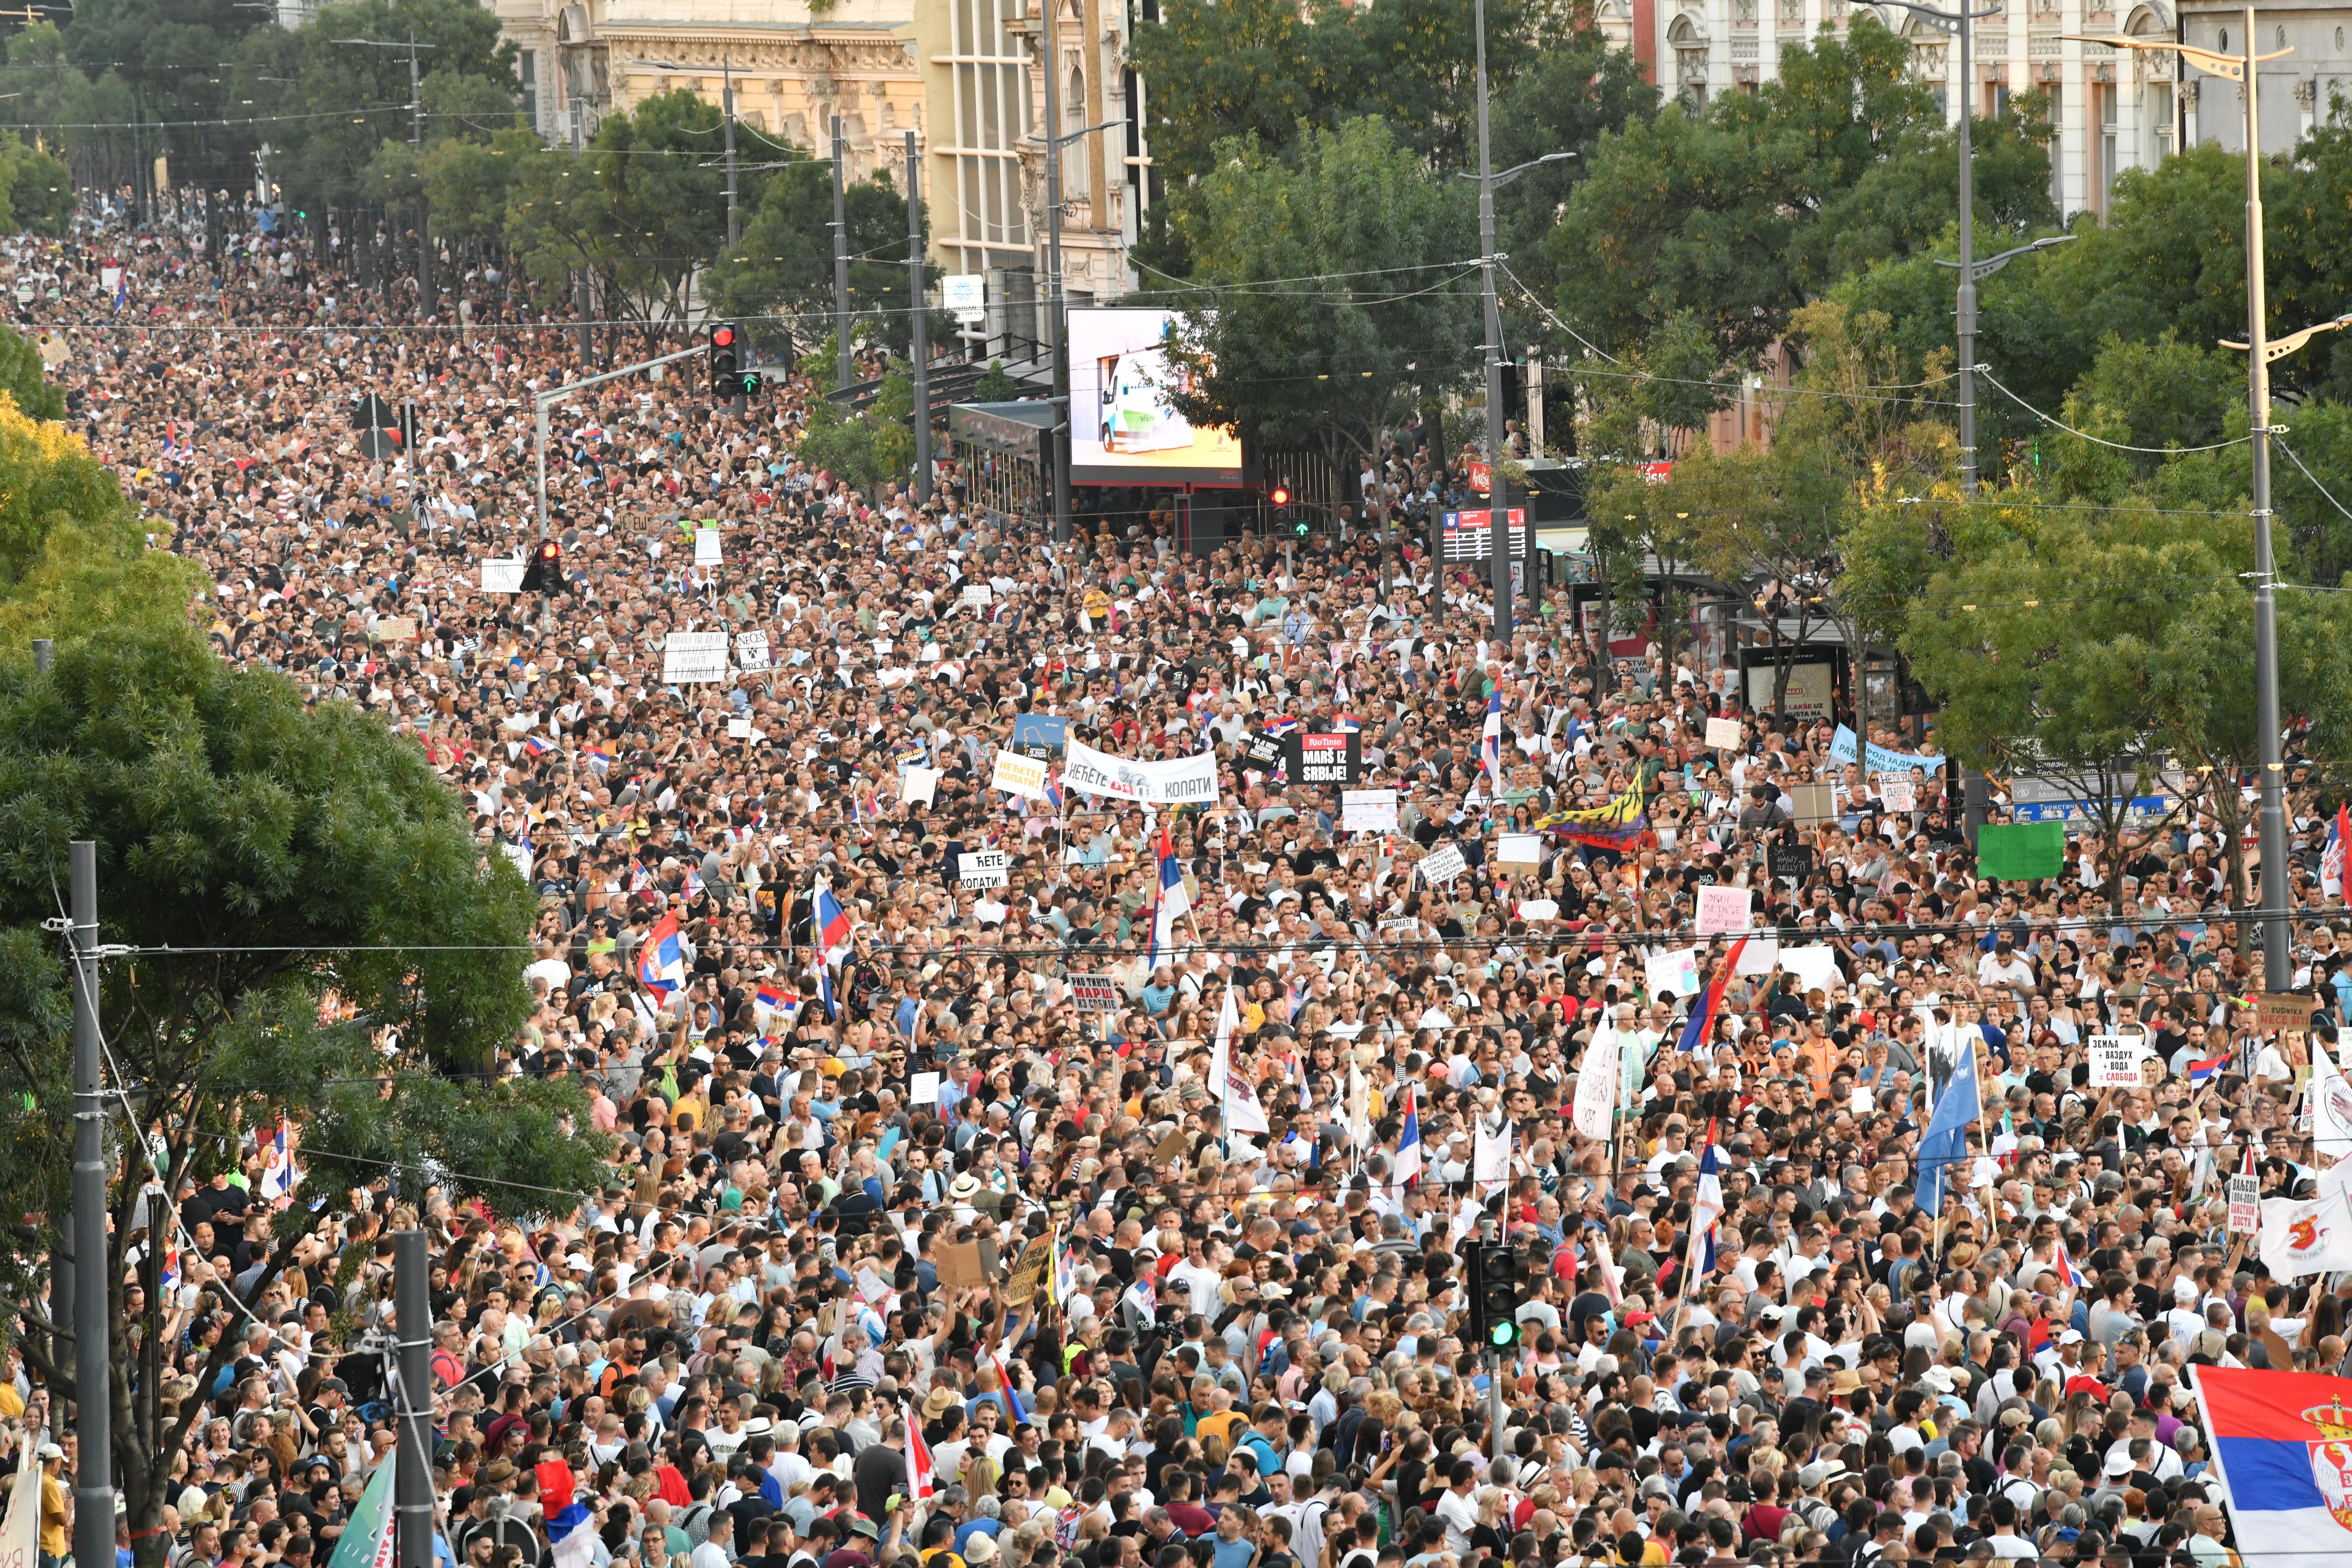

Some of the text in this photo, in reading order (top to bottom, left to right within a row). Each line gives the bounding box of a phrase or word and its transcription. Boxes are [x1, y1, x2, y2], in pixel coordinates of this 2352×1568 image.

[671, 635, 691, 645] КОЛИКО
[705, 635, 713, 644] ДА
[716, 634, 722, 643] СЕ
[738, 631, 765, 646] NEĆEŠ
[743, 658, 771, 673] PROĆI
[732, 721, 748, 730] NO
[1265, 741, 1279, 752] UKRAO
[896, 750, 914, 760] СРБИЈА
[1303, 747, 1347, 764] MARŠ IZ
[1000, 761, 1037, 778] НЕЋЕТЕ
[1303, 766, 1347, 781] SRBIJE!
[998, 771, 1041, 789] КОПАТИ!
[1069, 762, 1108, 787] НЕЋЕТЕ
[1165, 776, 1211, 798] КОПАТИ
[1881, 773, 1893, 785] НЕ
[2038, 791, 2067, 800] Moskva
[976, 855, 1003, 867] ЋЕТЕ
[1427, 850, 1447, 861] ВУЧИЋУ
[1777, 855, 1798, 865] НАШУ
[1423, 860, 1440, 869] КОПАЈ
[1443, 860, 1464, 871] ОСТАВИ
[961, 877, 1001, 889] КОПАТИ!
[1707, 893, 1732, 904] ЗБОГ
[1521, 904, 1530, 916] НЕ
[1704, 904, 1740, 914] МАТИЈЕ
[1384, 919, 1413, 928] КОПАЋЕТЕ
[1071, 977, 1111, 987] РИО ТИНТО
[1075, 988, 1113, 998] МАРШ
[1077, 999, 1116, 1010] ИЗ СРБИЈЕ
[2260, 1013, 2309, 1025] NEĆE BITI
[2105, 1051, 2132, 1060] ВАЗДУХ
[2110, 1062, 2128, 1071] ВОДА
[2107, 1073, 2137, 1082] СЛОБОДА
[2233, 1178, 2257, 1193] ВАЉЕВО
[2231, 1203, 2255, 1216] ПАМЕТНОМ
[2233, 1216, 2251, 1227] ДОСТА
